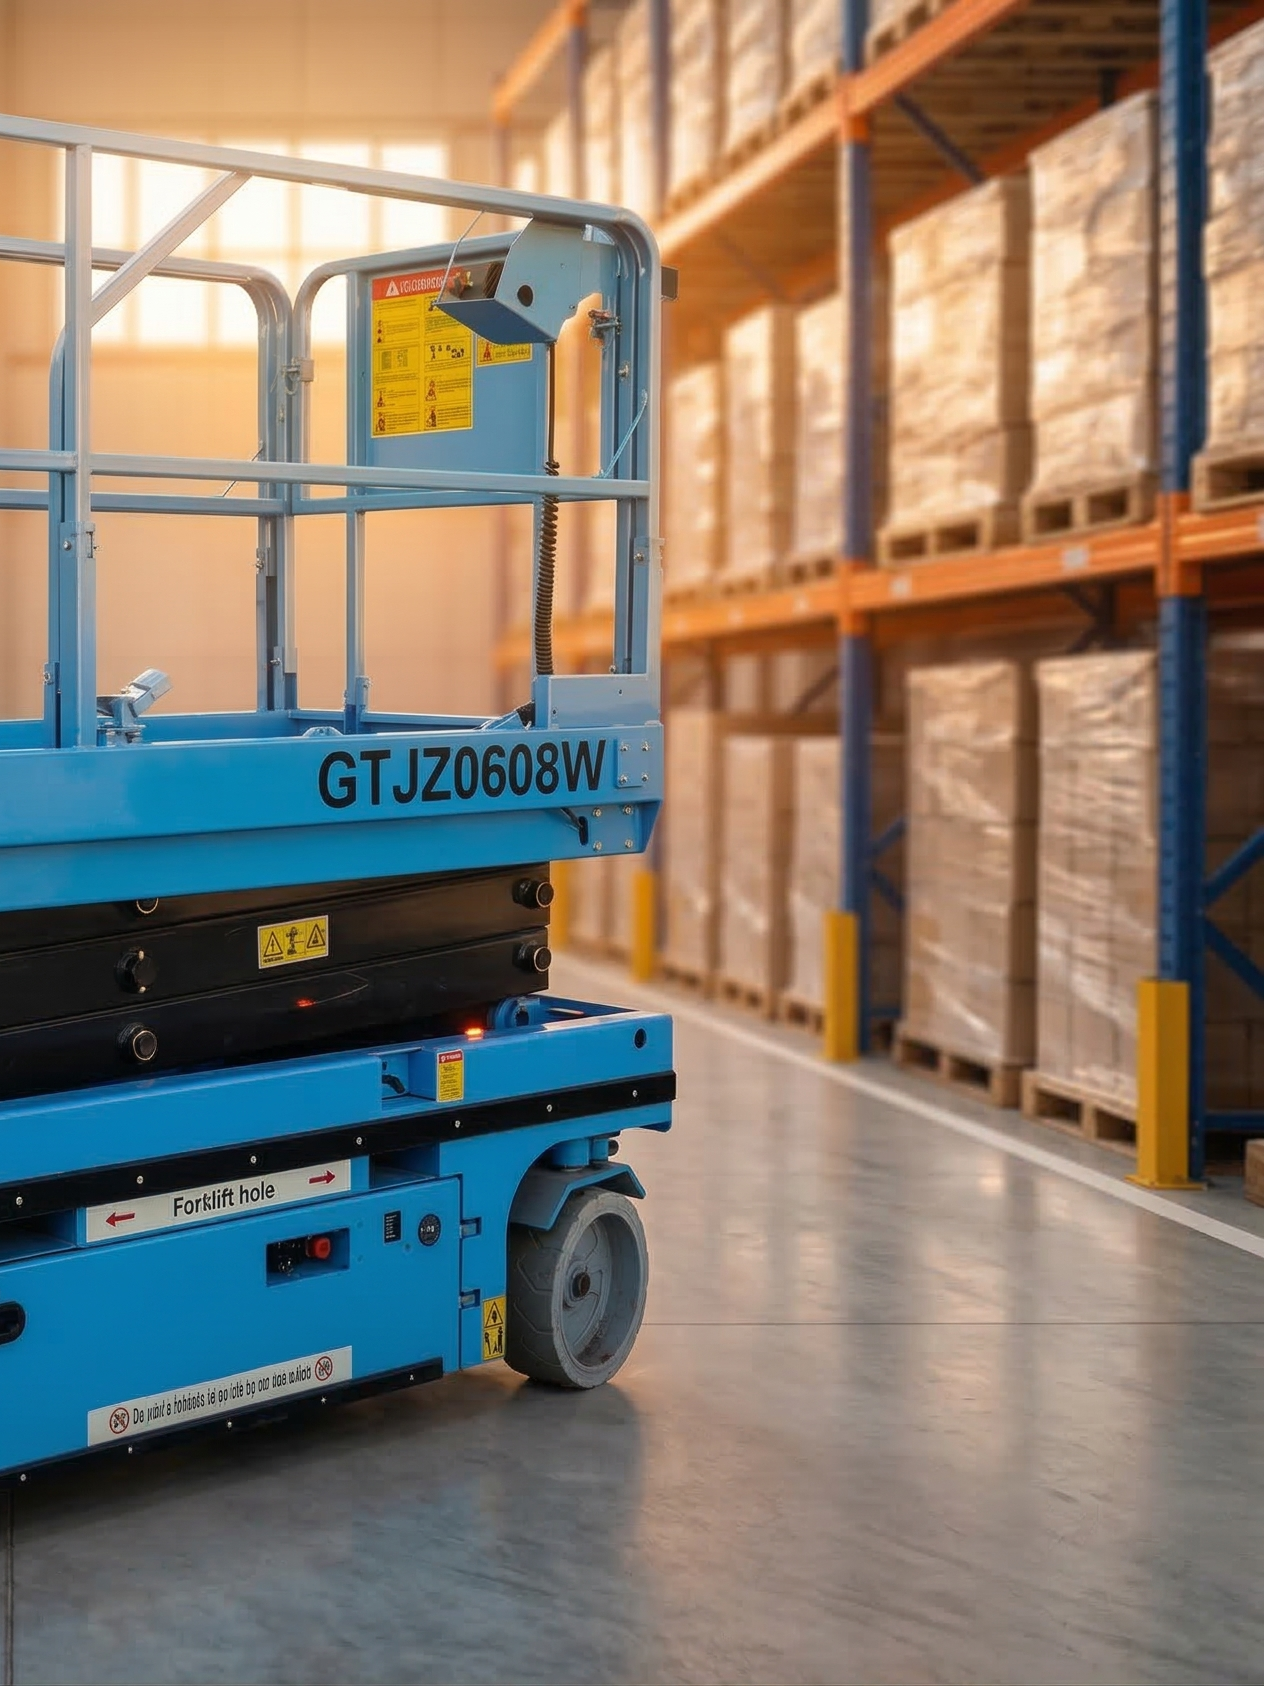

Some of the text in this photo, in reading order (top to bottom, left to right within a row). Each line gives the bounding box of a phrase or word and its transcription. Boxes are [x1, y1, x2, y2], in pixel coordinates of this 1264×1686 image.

[318, 739, 606, 809] GTJZ0608W
[173, 1180, 276, 1217] Forklift hole
